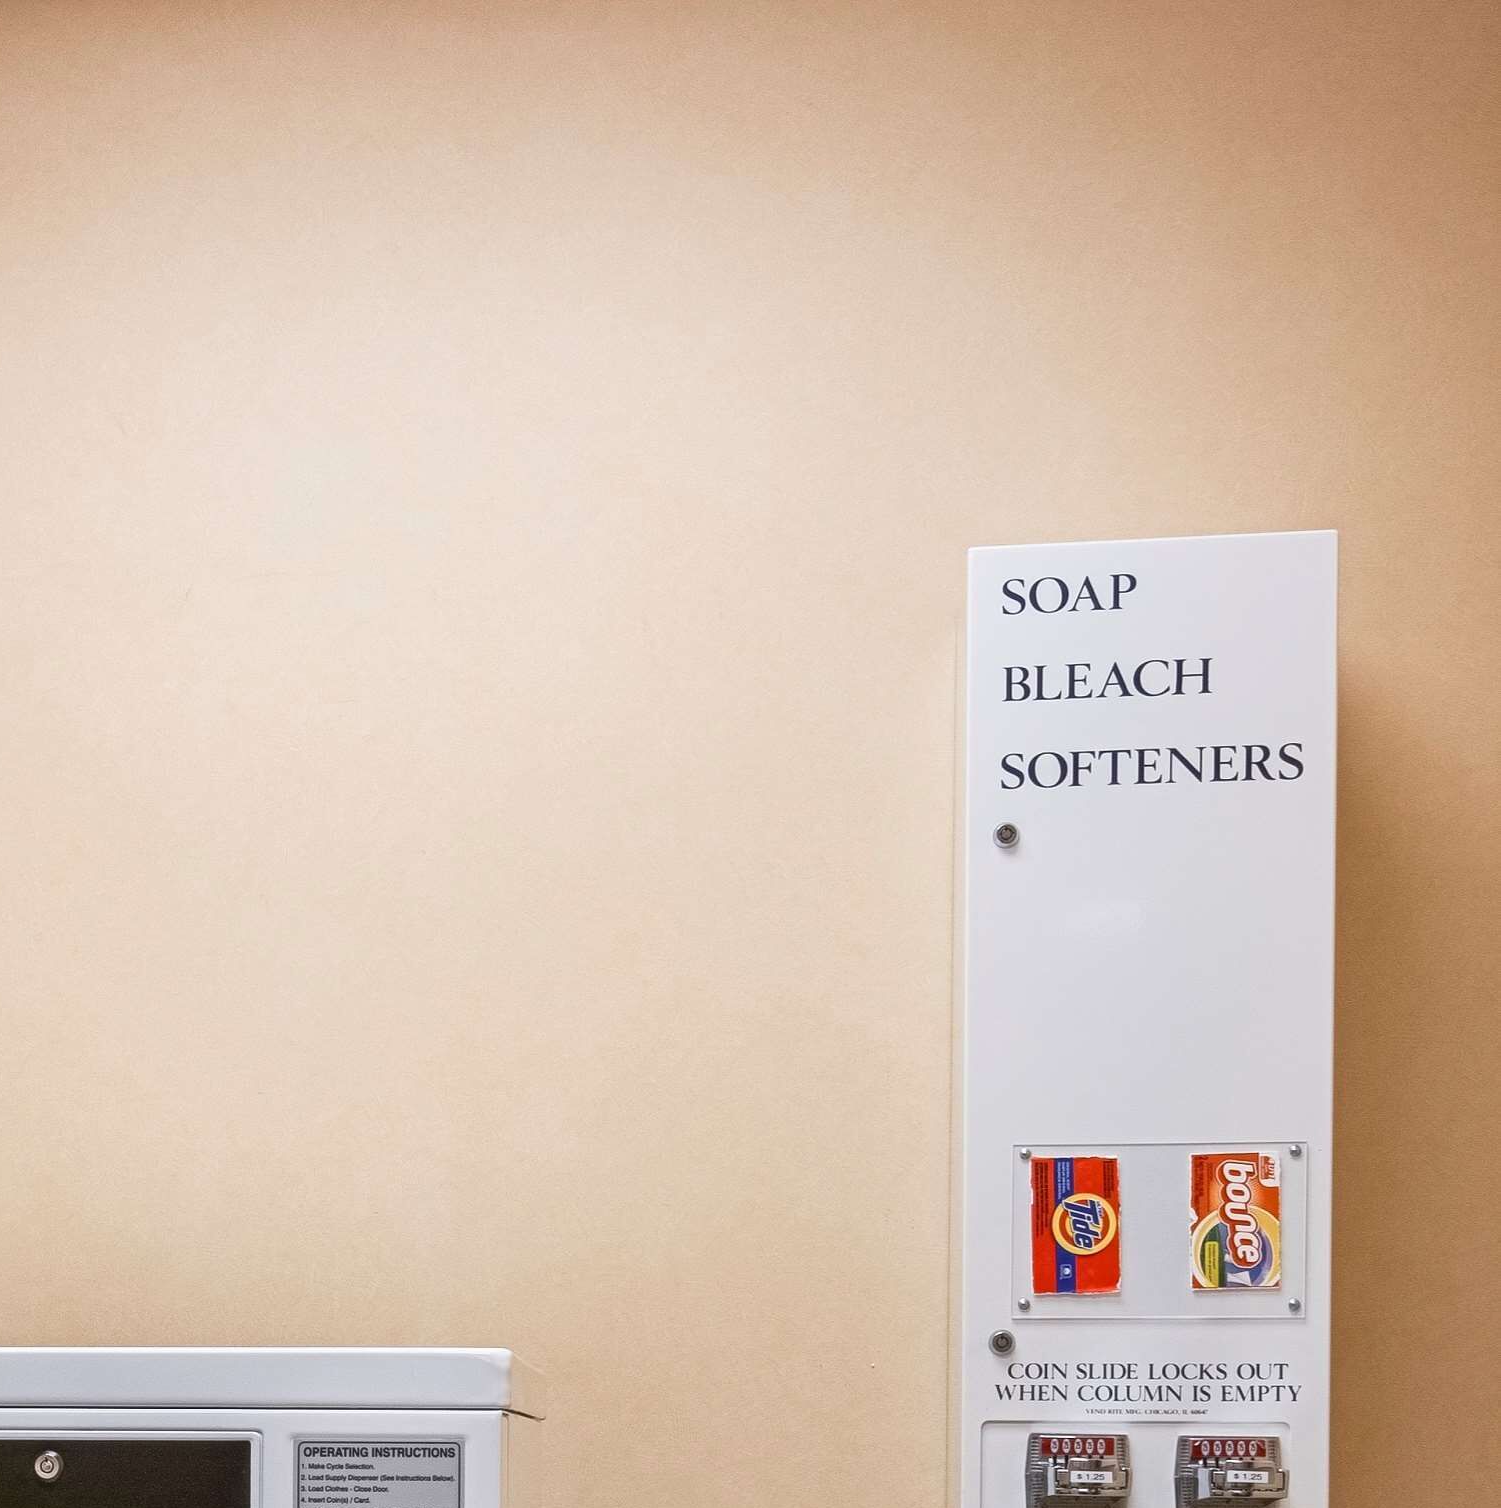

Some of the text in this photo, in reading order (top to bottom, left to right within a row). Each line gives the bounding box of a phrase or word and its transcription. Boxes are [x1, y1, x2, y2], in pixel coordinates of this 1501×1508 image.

[1001, 573, 1137, 615] SOAP
[1002, 658, 1213, 702] BLEACH
[1000, 743, 1305, 790] SOFTENERS
[1061, 1199, 1102, 1250] Tide
[1222, 1162, 1261, 1263] bounce
[1008, 1363, 1288, 1380] COIN SLIDE LOCKS OUT
[995, 1385, 1302, 1402] WHEN COLUMN IS EMPTY
[304, 1447, 455, 1458] OPERATING INSTRUCTIONS
